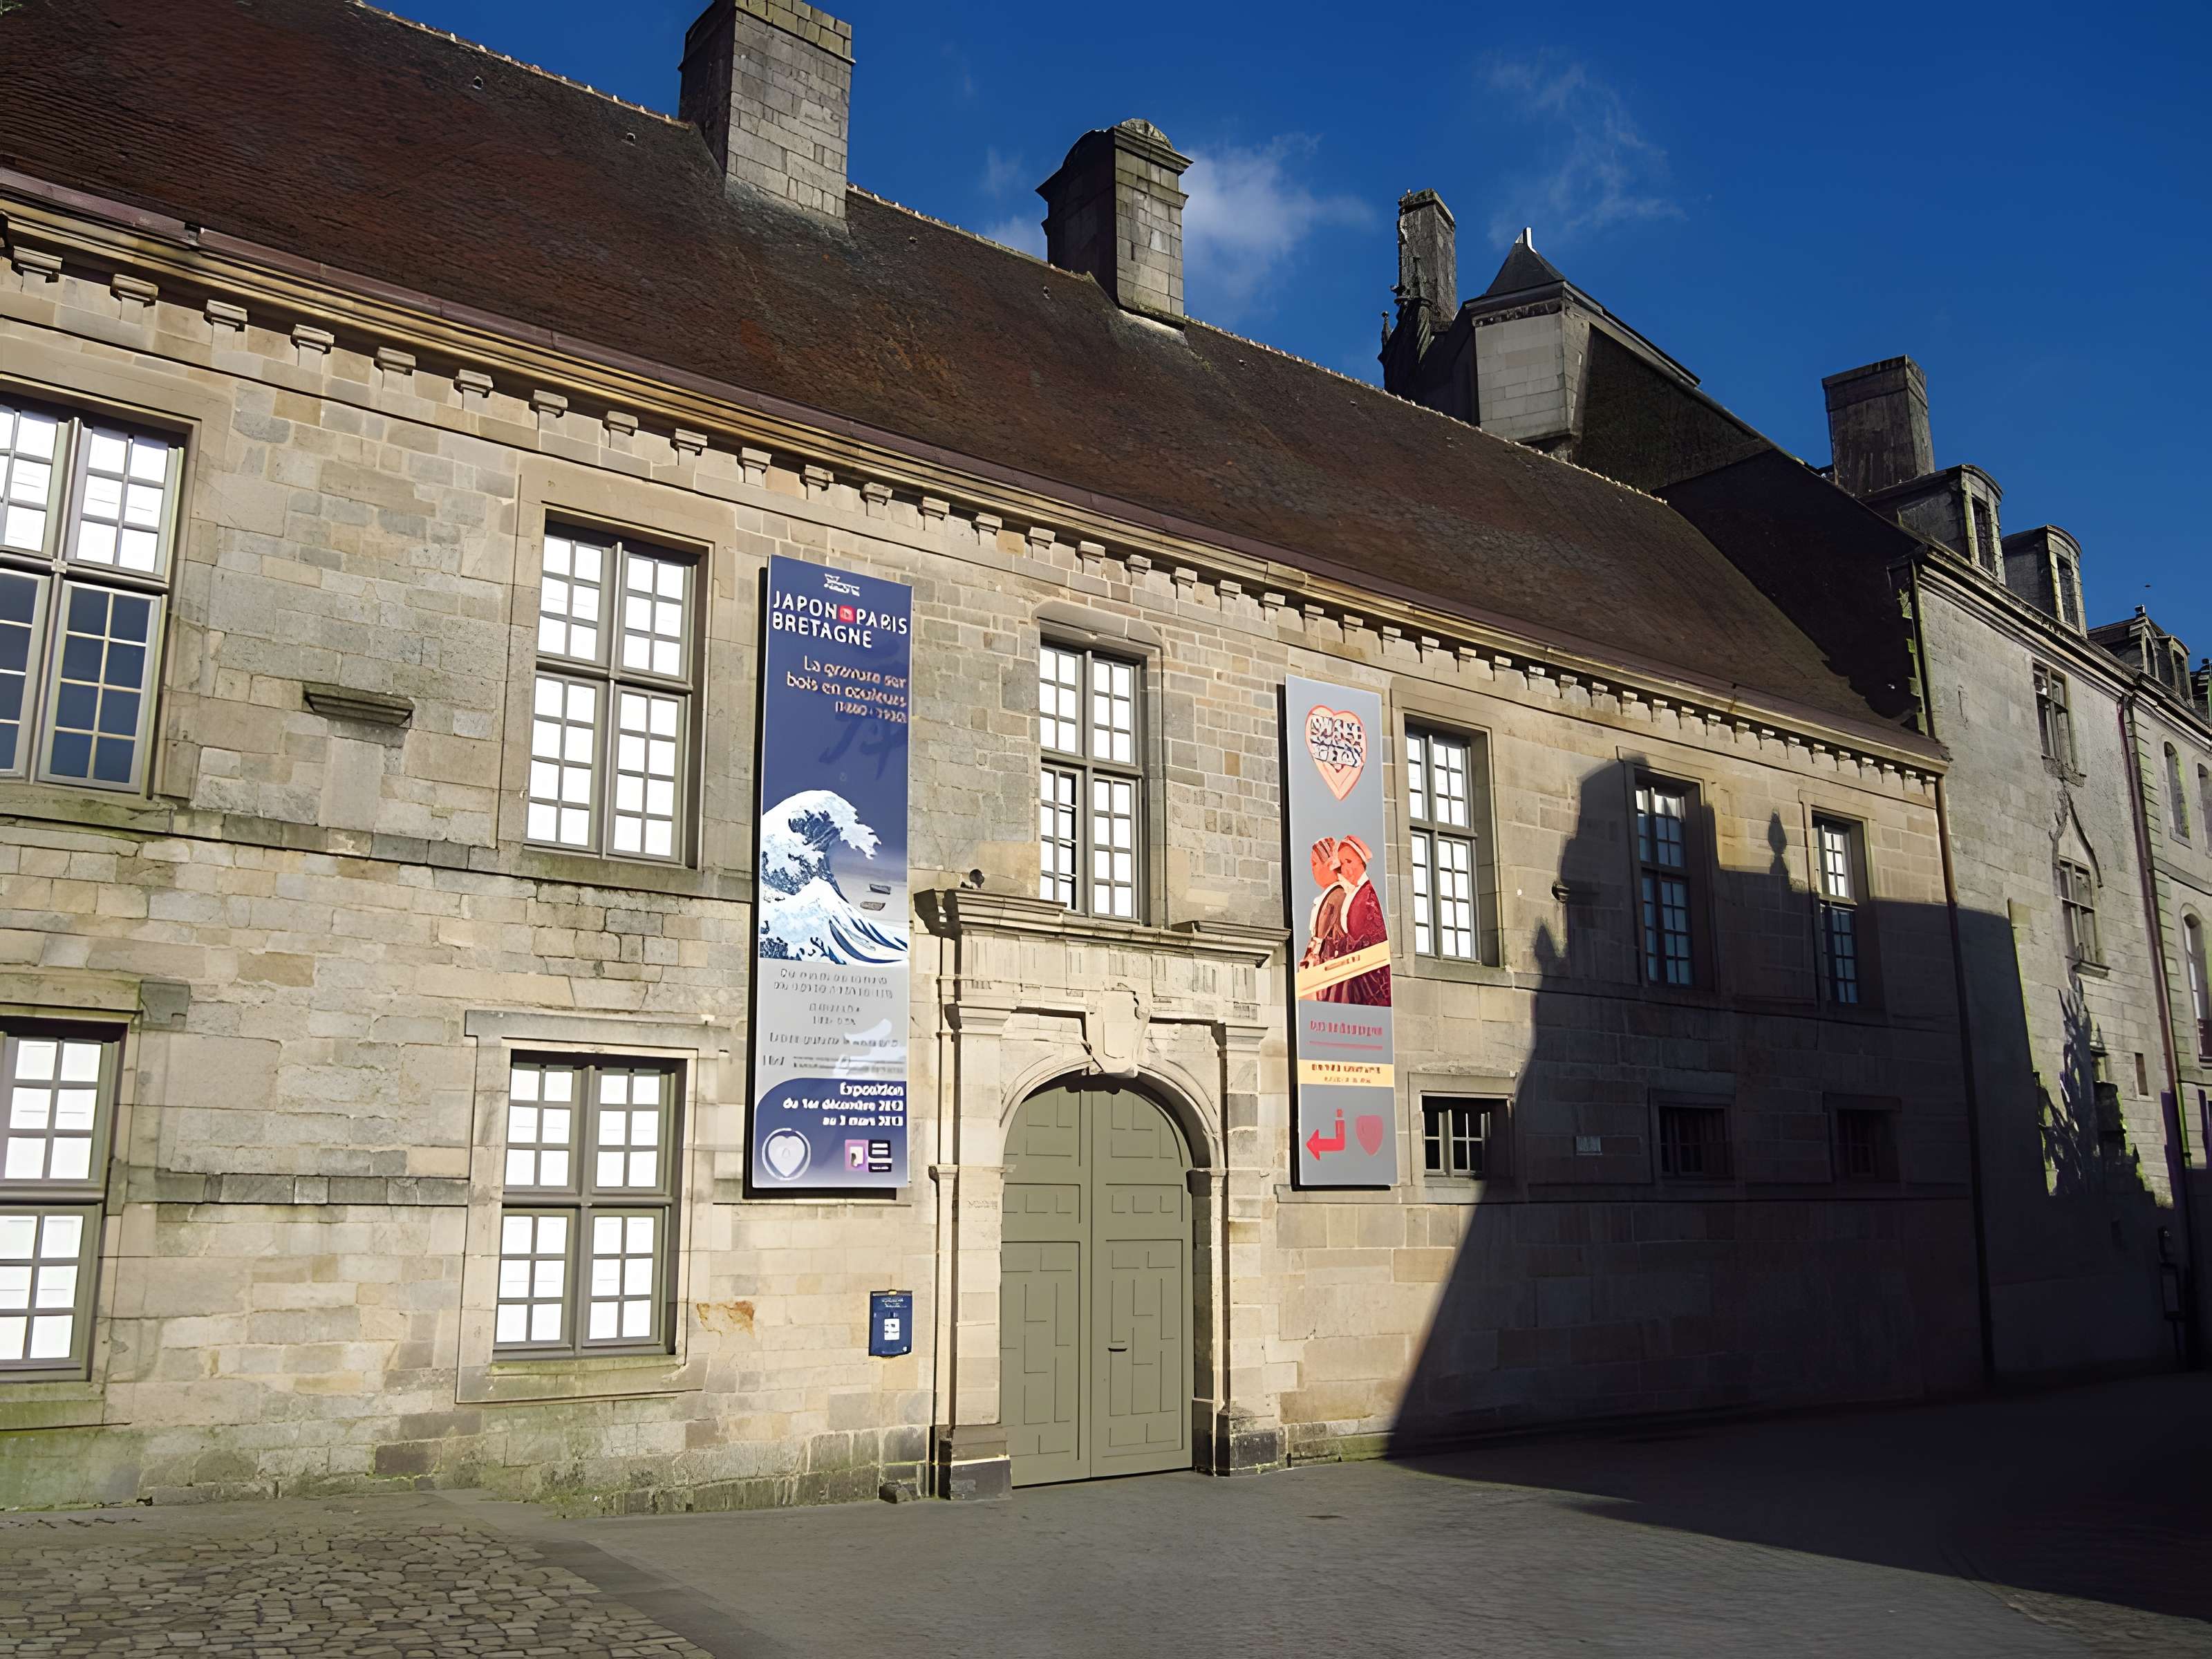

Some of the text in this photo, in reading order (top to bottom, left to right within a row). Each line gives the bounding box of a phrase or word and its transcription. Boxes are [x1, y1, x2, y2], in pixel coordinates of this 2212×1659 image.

[773, 590, 907, 635] JAPON PARIS
[772, 611, 872, 648] BRETAGNE
[804, 655, 821, 672] La
[787, 671, 818, 691] bois
